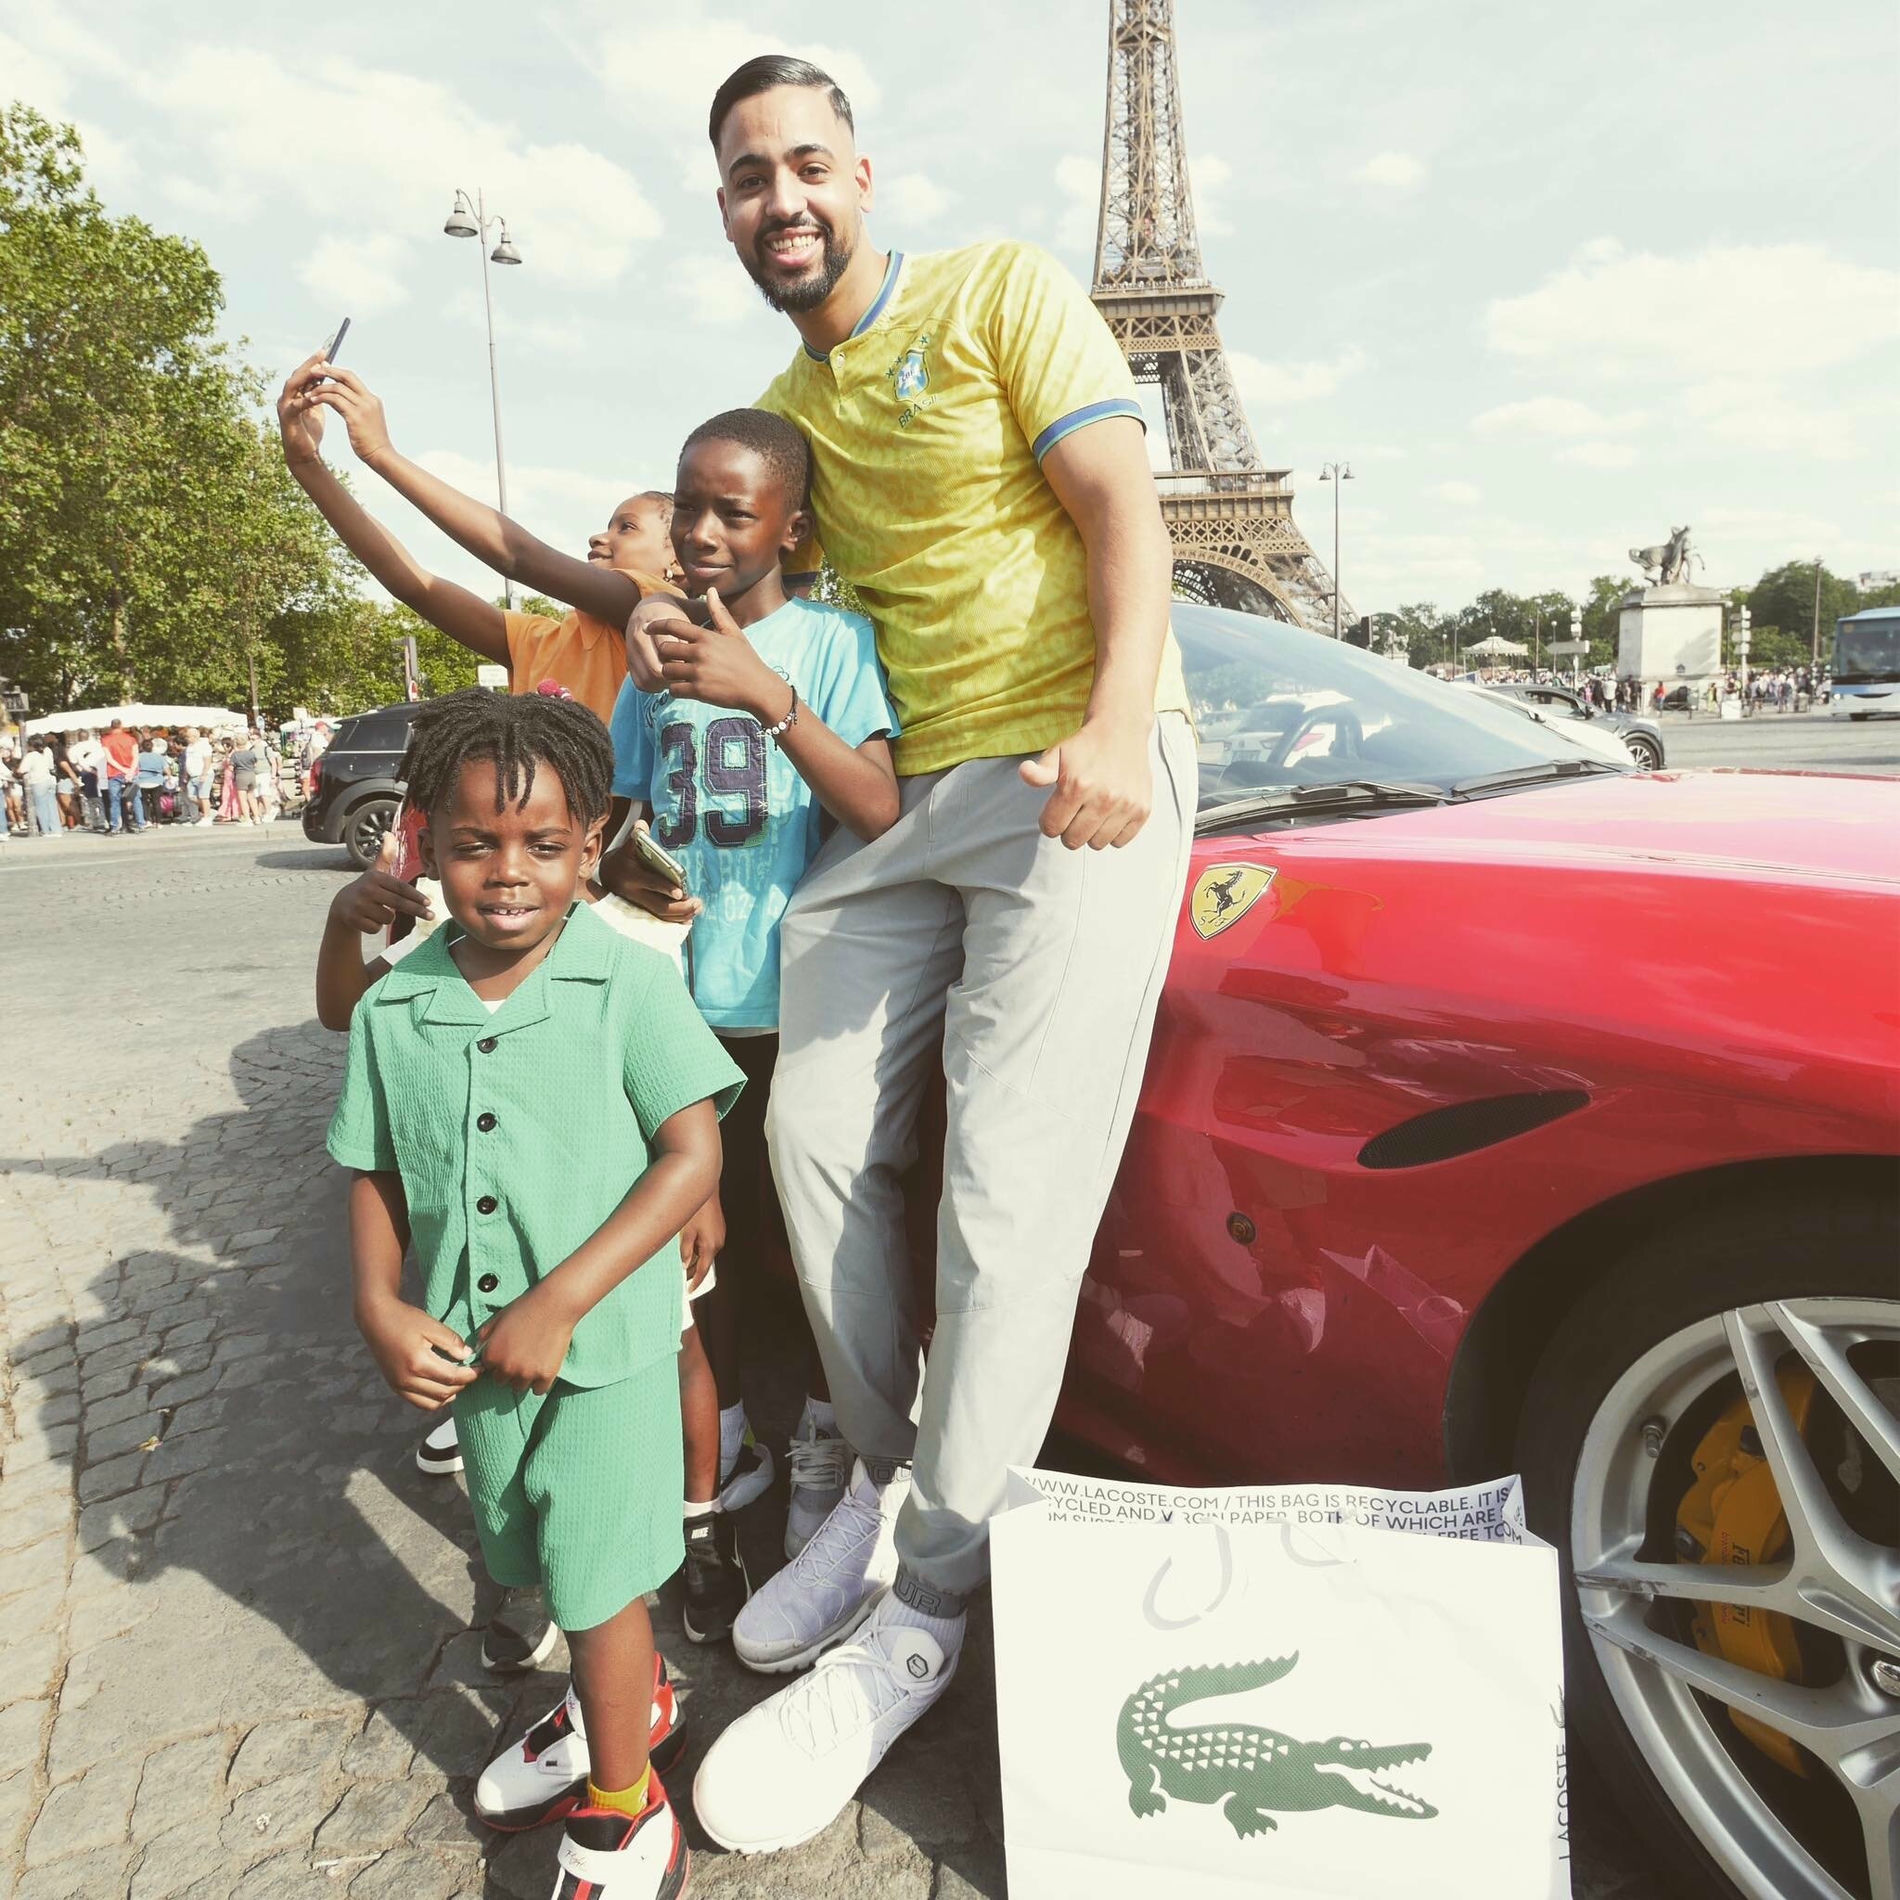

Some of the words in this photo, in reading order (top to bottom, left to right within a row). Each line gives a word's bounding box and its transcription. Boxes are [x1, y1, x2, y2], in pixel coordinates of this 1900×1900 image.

[658, 717, 768, 849] 39
[1047, 1495, 1111, 1516] YCLED
[1116, 1505, 1156, 1521] AND
[1386, 1515, 1456, 1530] WHICH
[1463, 1509, 1497, 1526] ARE
[1235, 1495, 1276, 1509] THIS
[1282, 1493, 1320, 1508] BAG
[1325, 1494, 1340, 1508] IS
[1346, 1495, 1473, 1514] RECYCLABLE.
[1478, 1491, 1493, 1508] IT
[1496, 1487, 1510, 1504] IS
